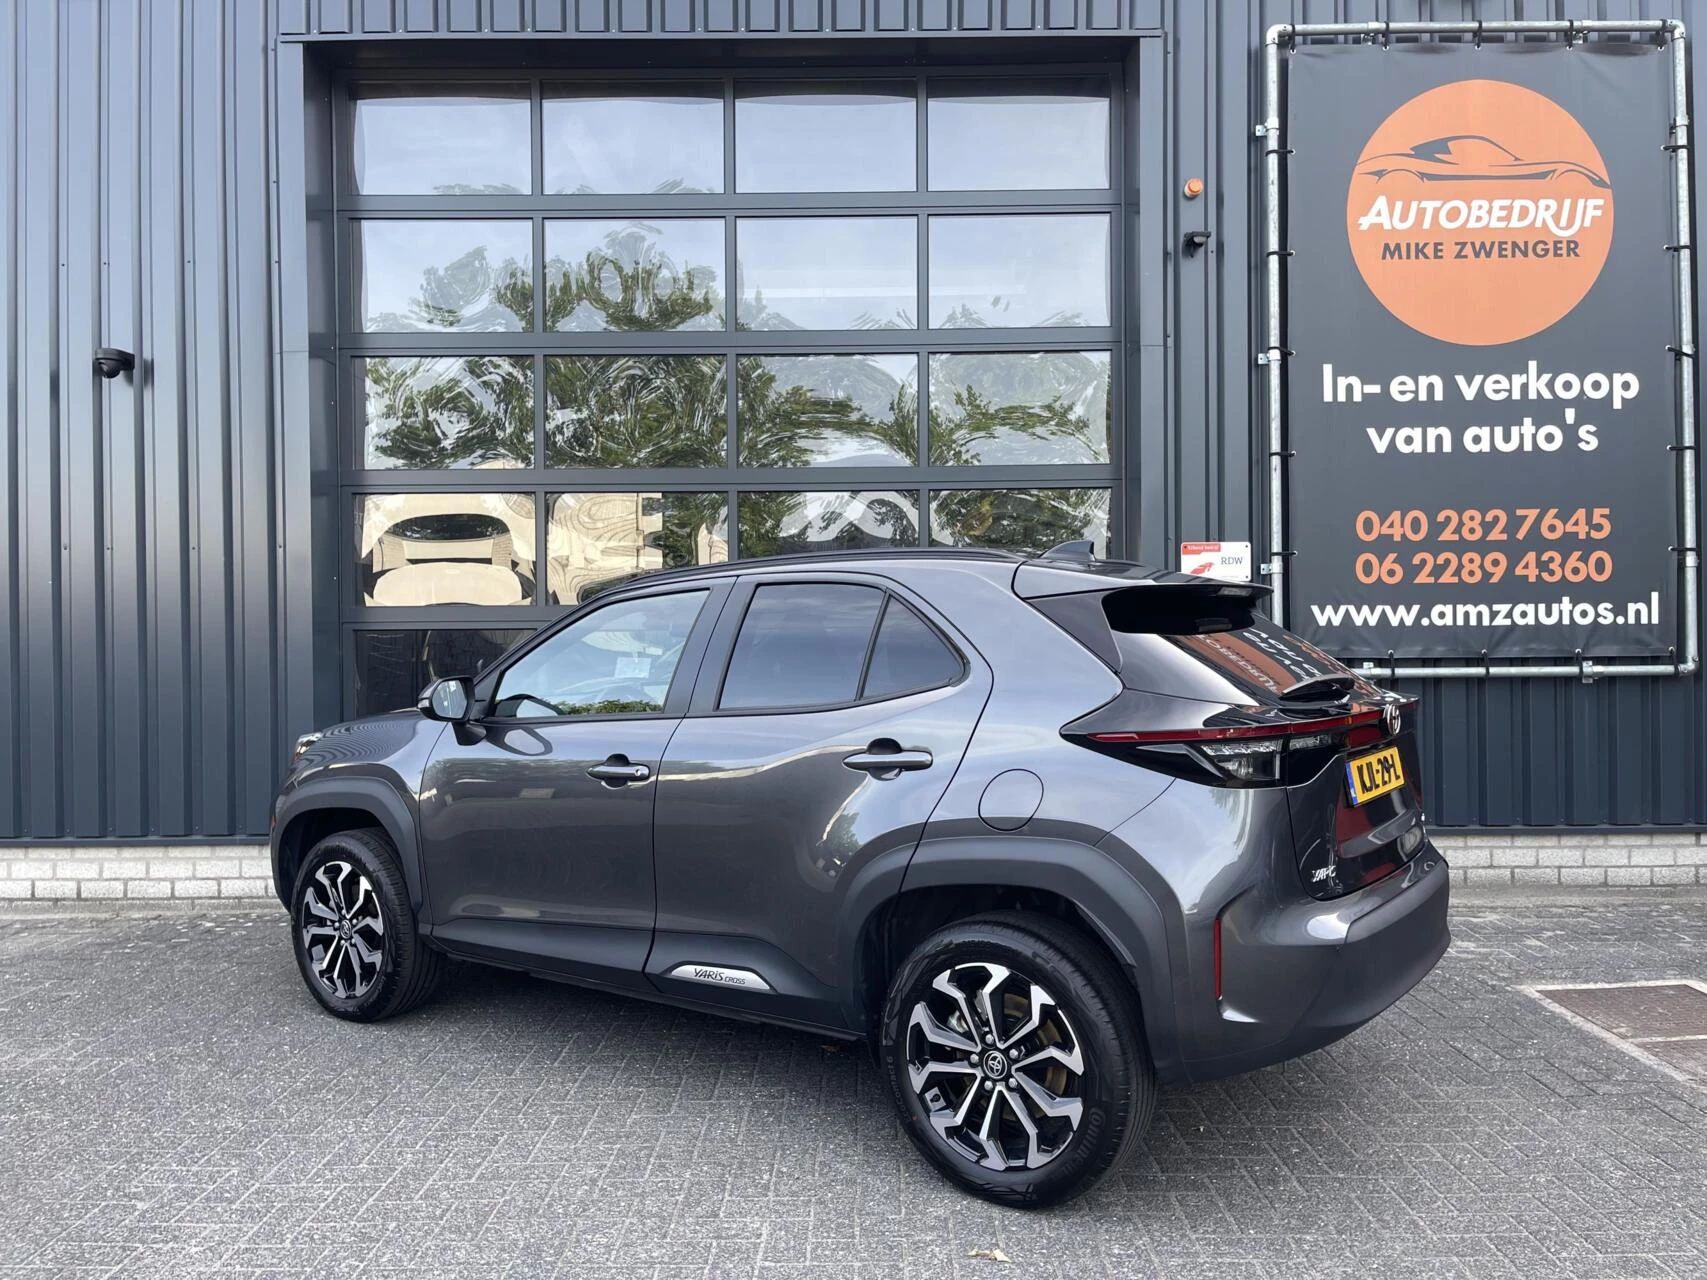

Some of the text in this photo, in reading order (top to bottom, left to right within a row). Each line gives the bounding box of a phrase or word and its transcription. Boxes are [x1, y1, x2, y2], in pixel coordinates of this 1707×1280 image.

[1358, 195, 1605, 237] AUTOBEDRIJF
[1381, 239, 1581, 261] MIKE ZWENGER
[1322, 360, 1640, 409] In- en verkoop
[1366, 408, 1599, 453] van auto's
[1355, 507, 1612, 542] 040 282 7645
[1220, 556, 1243, 565] RDW
[1355, 550, 1613, 584] 06 2289 4360
[1310, 591, 1660, 627] www.amzautos.nl
